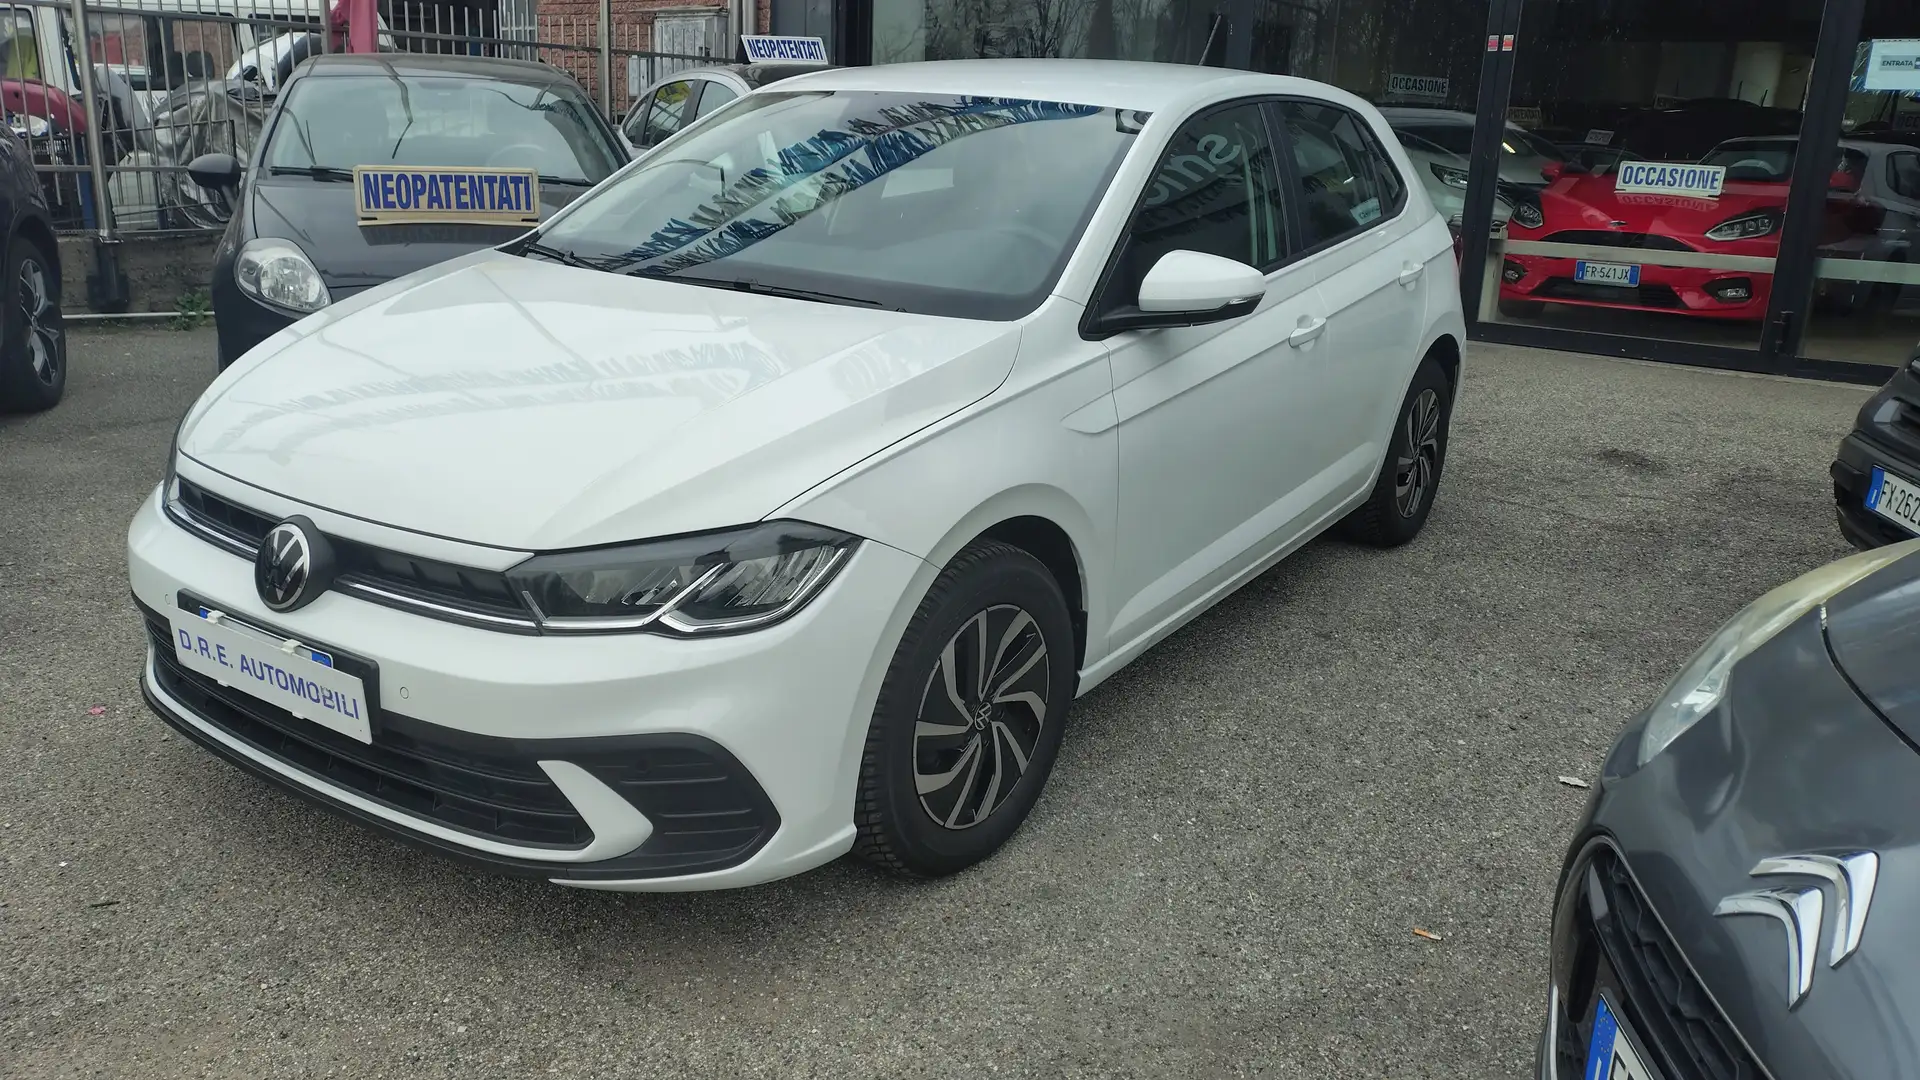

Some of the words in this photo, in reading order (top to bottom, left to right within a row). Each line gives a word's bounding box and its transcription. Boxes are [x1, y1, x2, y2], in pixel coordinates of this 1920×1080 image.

[746, 38, 824, 60] NEOPATENTATI
[1391, 76, 1447, 93] OCCASIONE
[1622, 165, 1721, 190] OCCASIONE
[362, 173, 532, 211] NEOPATENTATI
[178, 628, 234, 669] D.R.E.
[240, 653, 360, 720] AUTOMOBILI
